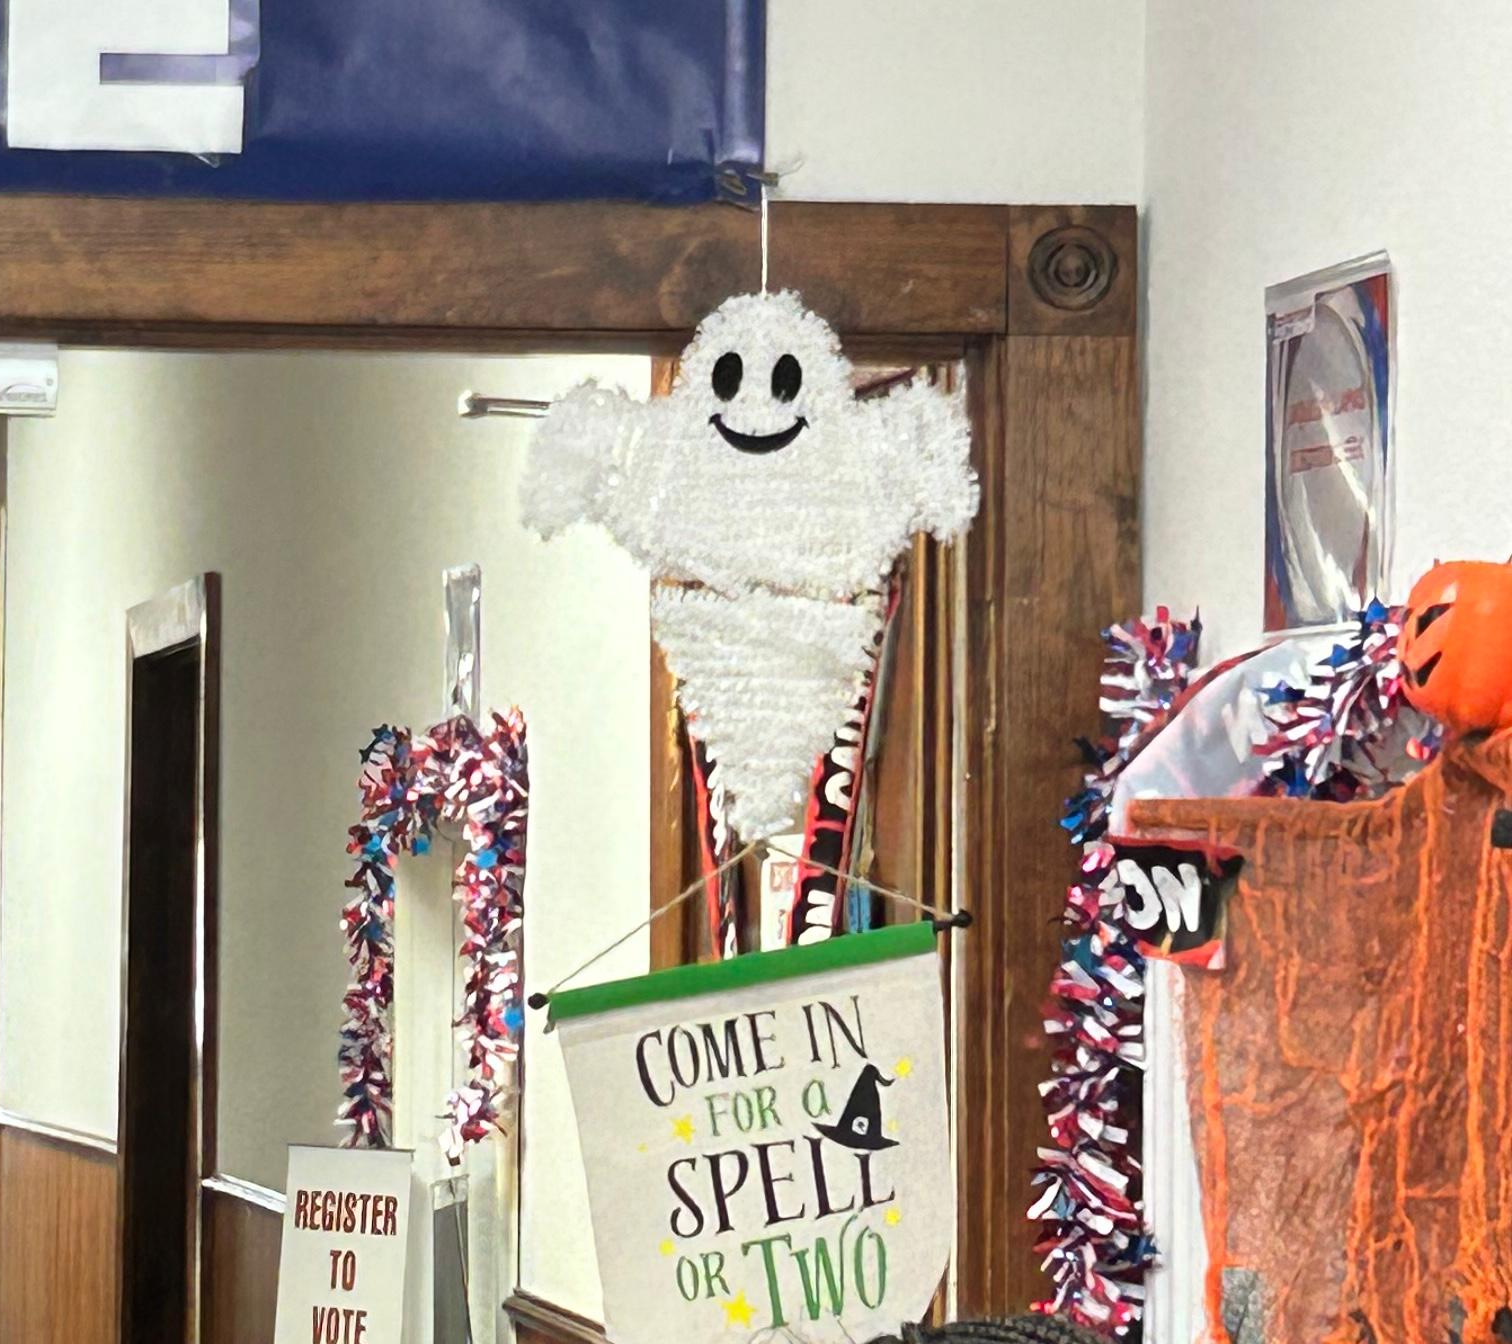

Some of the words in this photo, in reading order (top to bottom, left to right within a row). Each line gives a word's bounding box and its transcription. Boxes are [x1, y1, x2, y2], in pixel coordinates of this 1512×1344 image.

[636, 1009, 786, 1107] COME
[801, 995, 869, 1069] IN
[704, 1085, 782, 1137] FOR
[294, 1189, 399, 1236] REGISTER
[667, 1135, 896, 1239] SPELL
[329, 1249, 356, 1291] TO
[676, 1251, 731, 1302] OR
[740, 1213, 888, 1329] TWO
